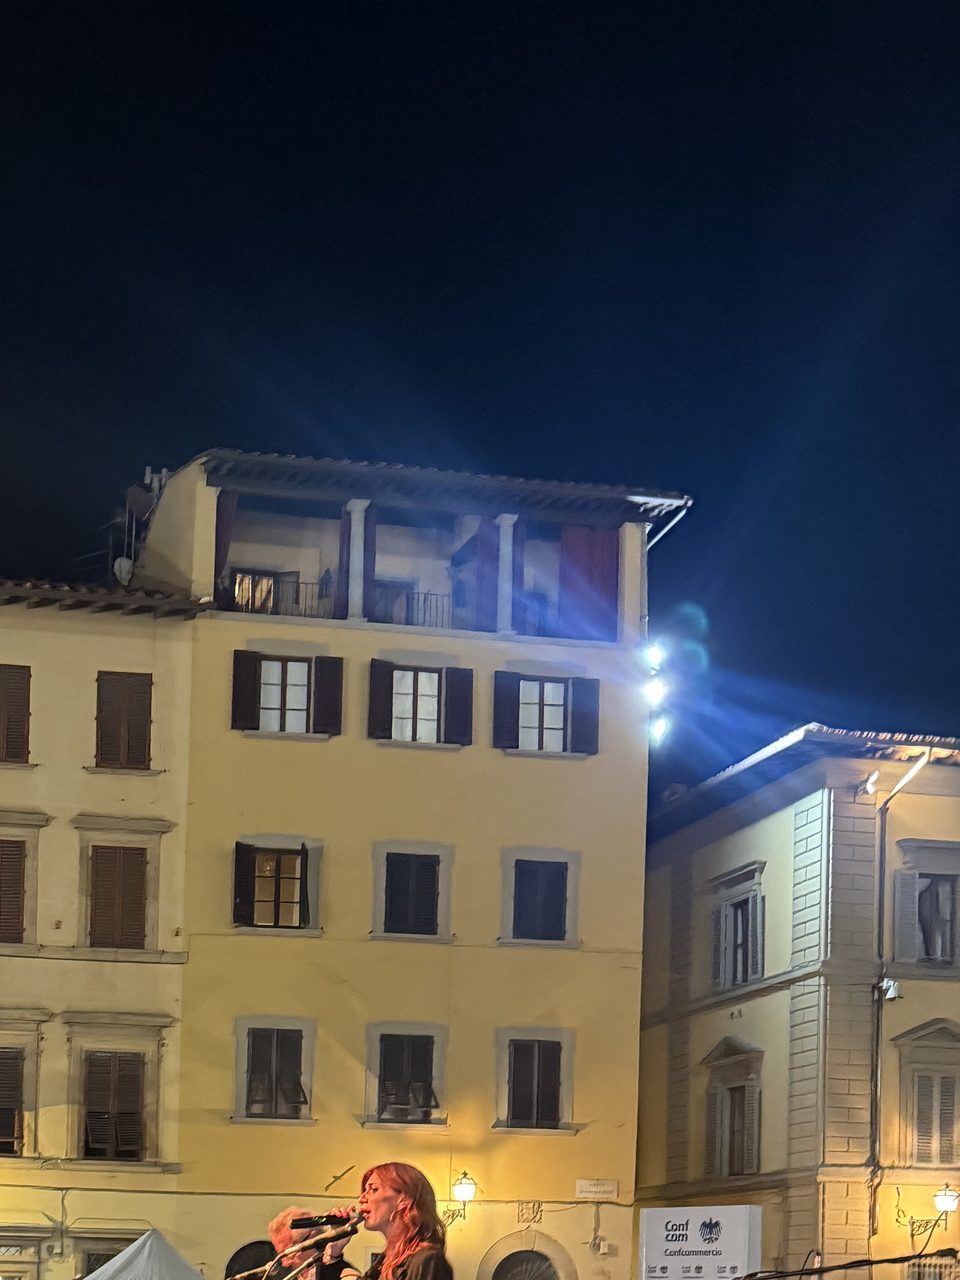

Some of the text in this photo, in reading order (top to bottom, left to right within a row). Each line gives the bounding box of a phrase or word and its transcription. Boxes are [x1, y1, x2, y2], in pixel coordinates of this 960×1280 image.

[664, 1218, 690, 1232] Conf
[664, 1233, 688, 1242] com
[664, 1247, 723, 1257] Confcommercio
